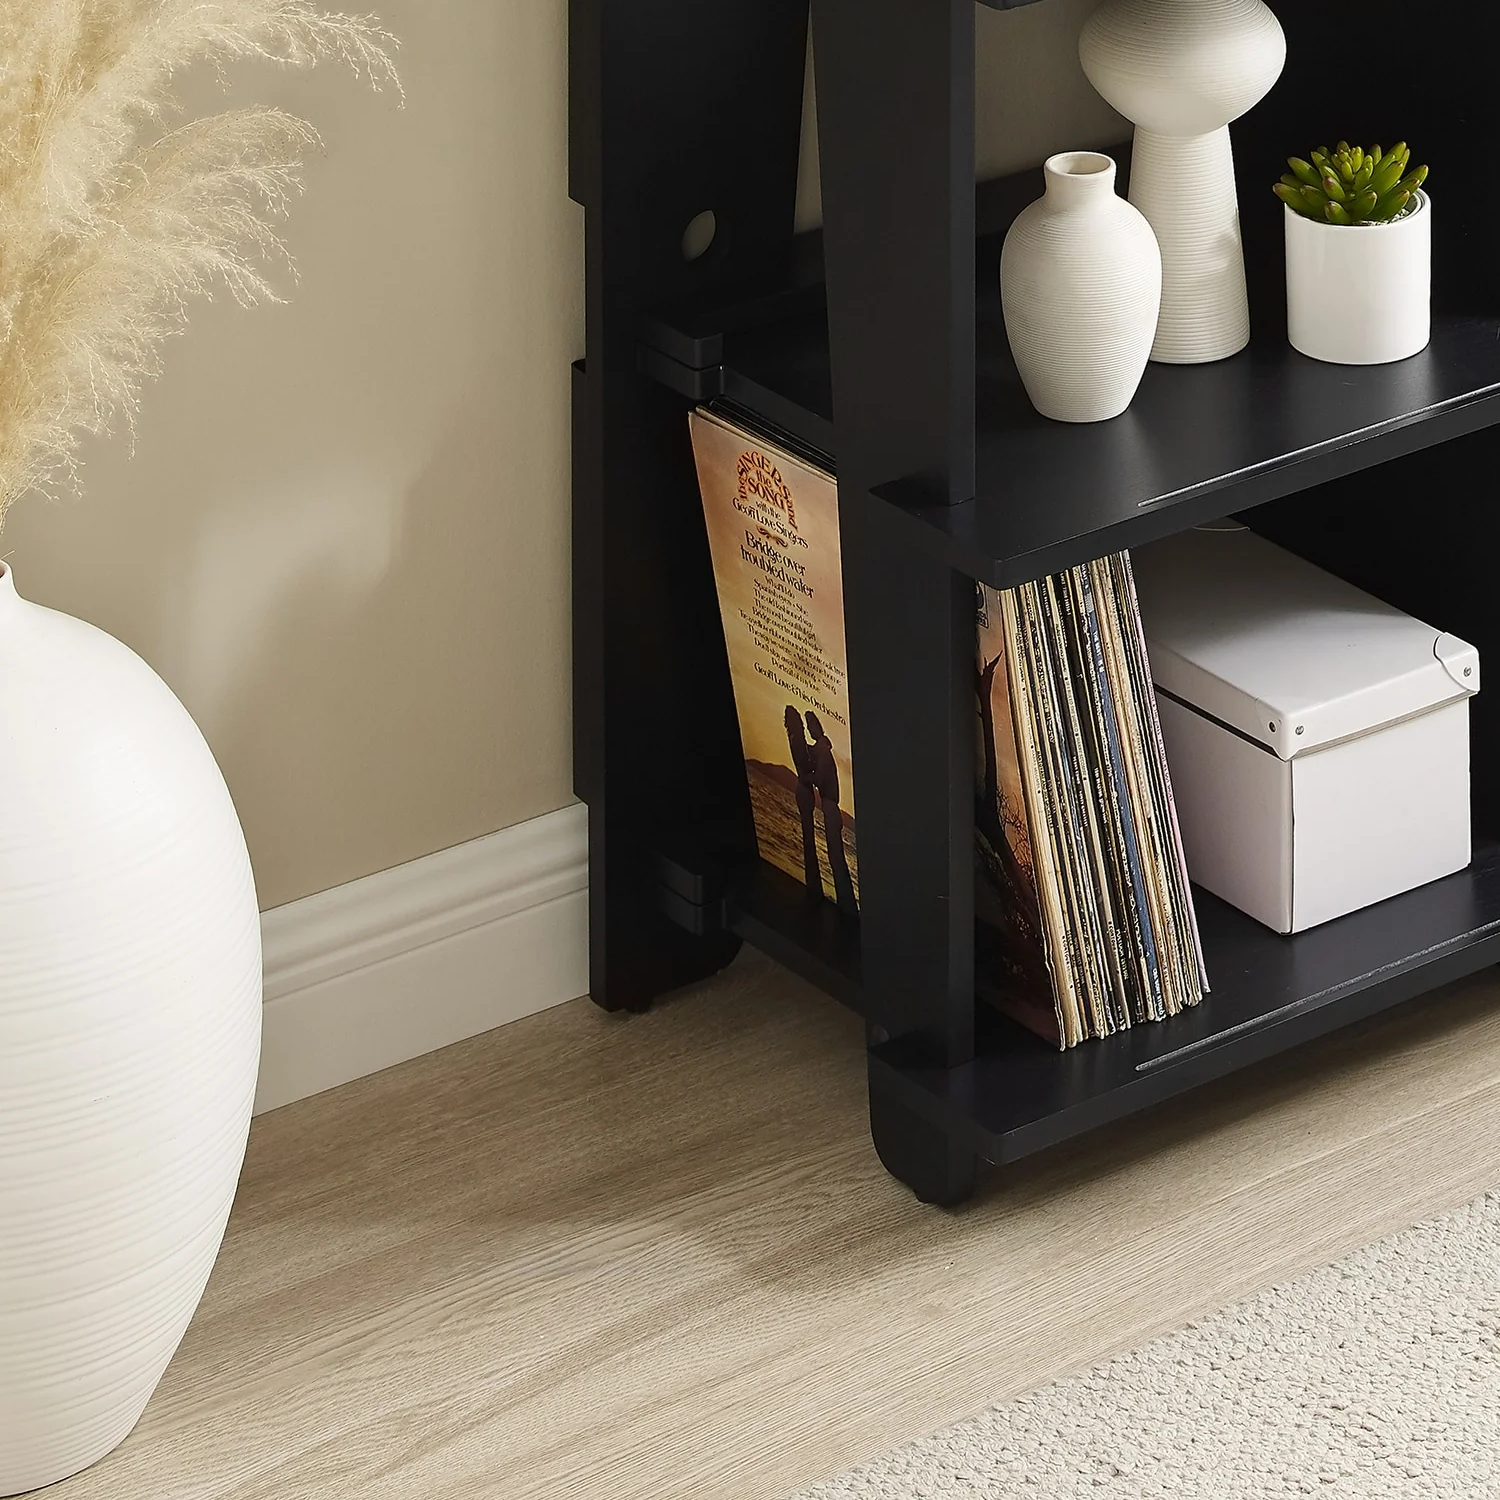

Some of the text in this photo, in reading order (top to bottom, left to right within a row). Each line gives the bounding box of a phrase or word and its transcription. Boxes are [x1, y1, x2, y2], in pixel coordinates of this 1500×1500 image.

[737, 450, 791, 500] SINGERS
[748, 477, 786, 511] SONG
[745, 529, 805, 576] Bridge over
[756, 509, 775, 530] Love
[776, 521, 808, 549] Singers
[740, 544, 813, 598] troubled water
